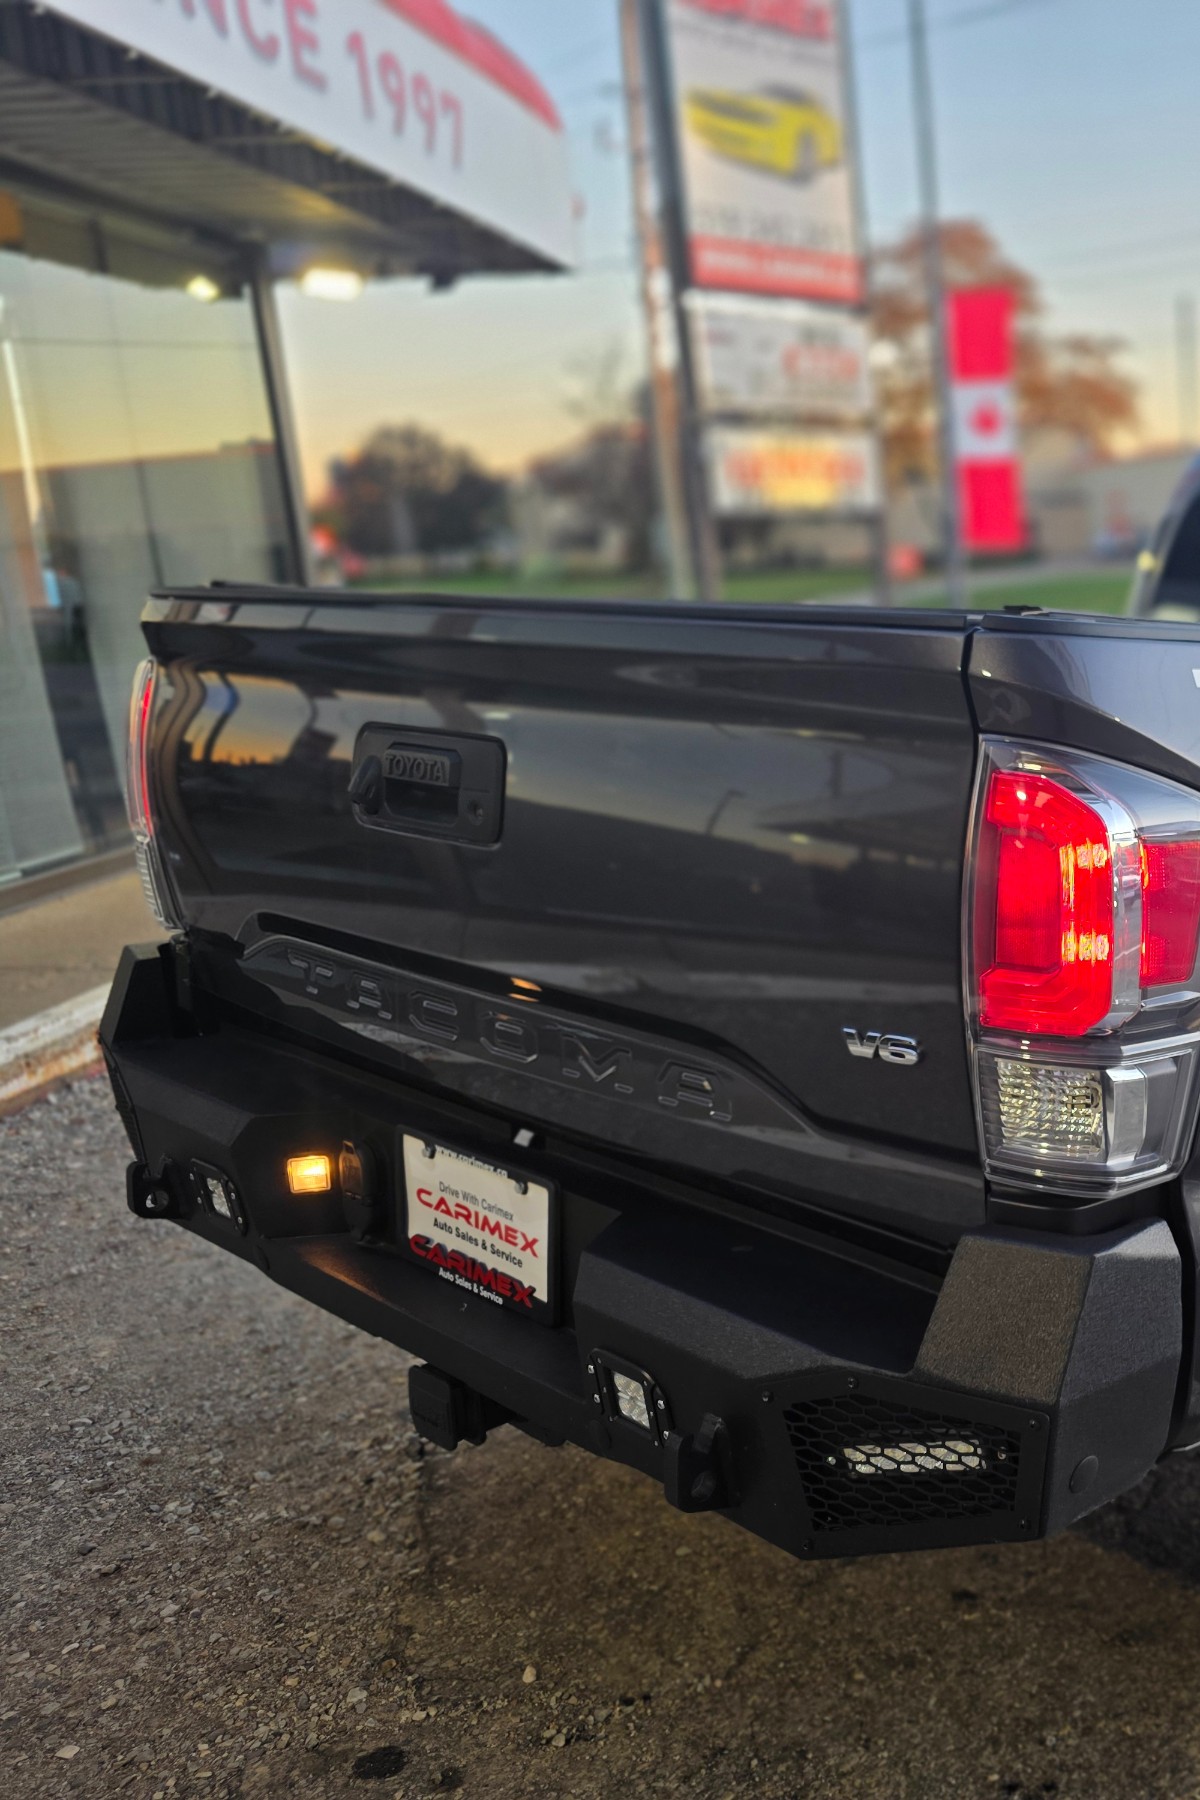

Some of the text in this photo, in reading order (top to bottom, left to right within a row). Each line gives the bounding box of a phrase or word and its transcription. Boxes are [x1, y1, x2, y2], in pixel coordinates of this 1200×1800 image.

[346, 31, 462, 170] 1997
[385, 752, 448, 783] TOYOTA
[286, 948, 734, 1122] TACOMA
[842, 1027, 921, 1066] V6
[416, 1187, 540, 1259] CARIMEX
[438, 1180, 515, 1222] Drive With Carimex
[433, 1217, 524, 1269] Auto Sales & Service
[409, 1233, 537, 1309] CARIMEX
[438, 1266, 504, 1306] Auto Sales & Service
